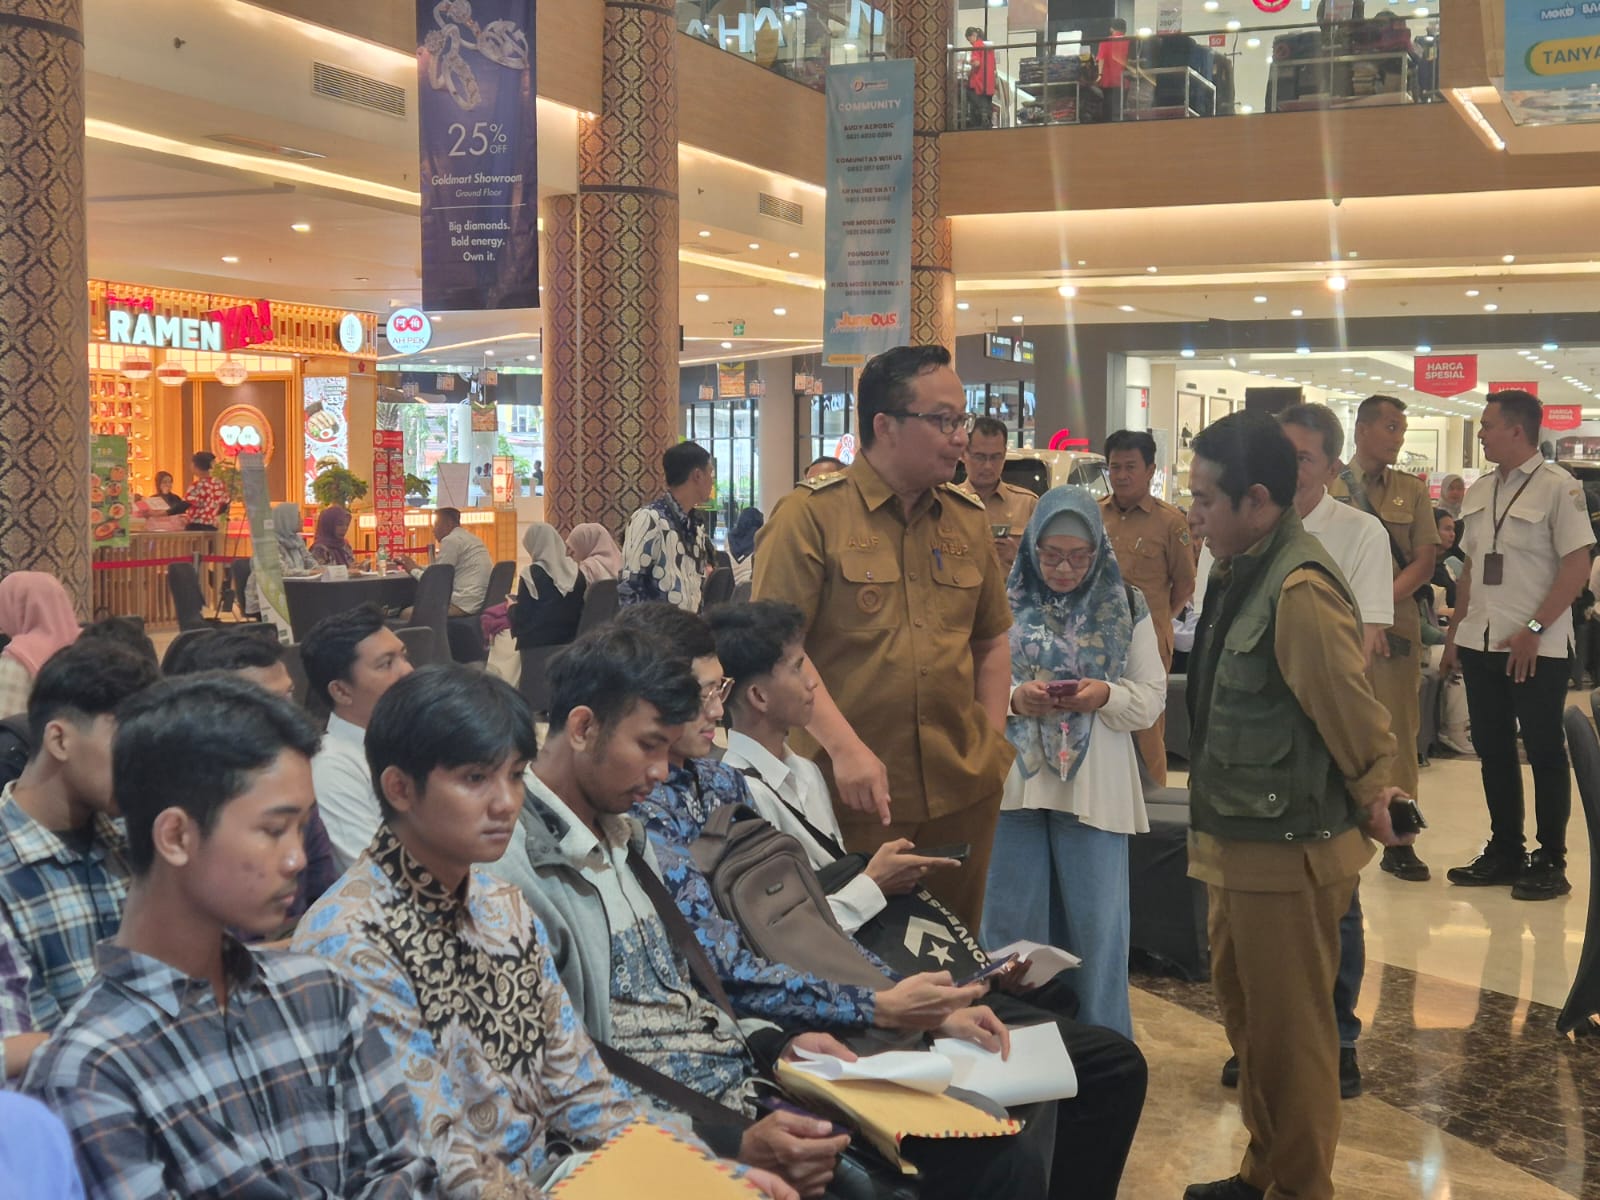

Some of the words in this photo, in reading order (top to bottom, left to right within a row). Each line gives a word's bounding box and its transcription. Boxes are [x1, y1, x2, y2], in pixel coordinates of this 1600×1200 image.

[1583, 2, 1600, 14] BA
[838, 99, 900, 112] COMMUNITY
[490, 145, 507, 154] OFF
[432, 174, 472, 186] Goldmart
[474, 173, 522, 184] Showroom
[456, 189, 481, 198] Ground
[483, 189, 502, 197] Floor
[449, 221, 462, 234] Big
[464, 220, 510, 231] diamonds.
[451, 236, 469, 247] Bold
[471, 237, 505, 249] energy.
[463, 251, 484, 262] Own
[486, 251, 496, 261] it.
[109, 310, 221, 351] RAMEN
[1427, 362, 1464, 371] HARGA
[1424, 371, 1465, 380] SPESIAL
